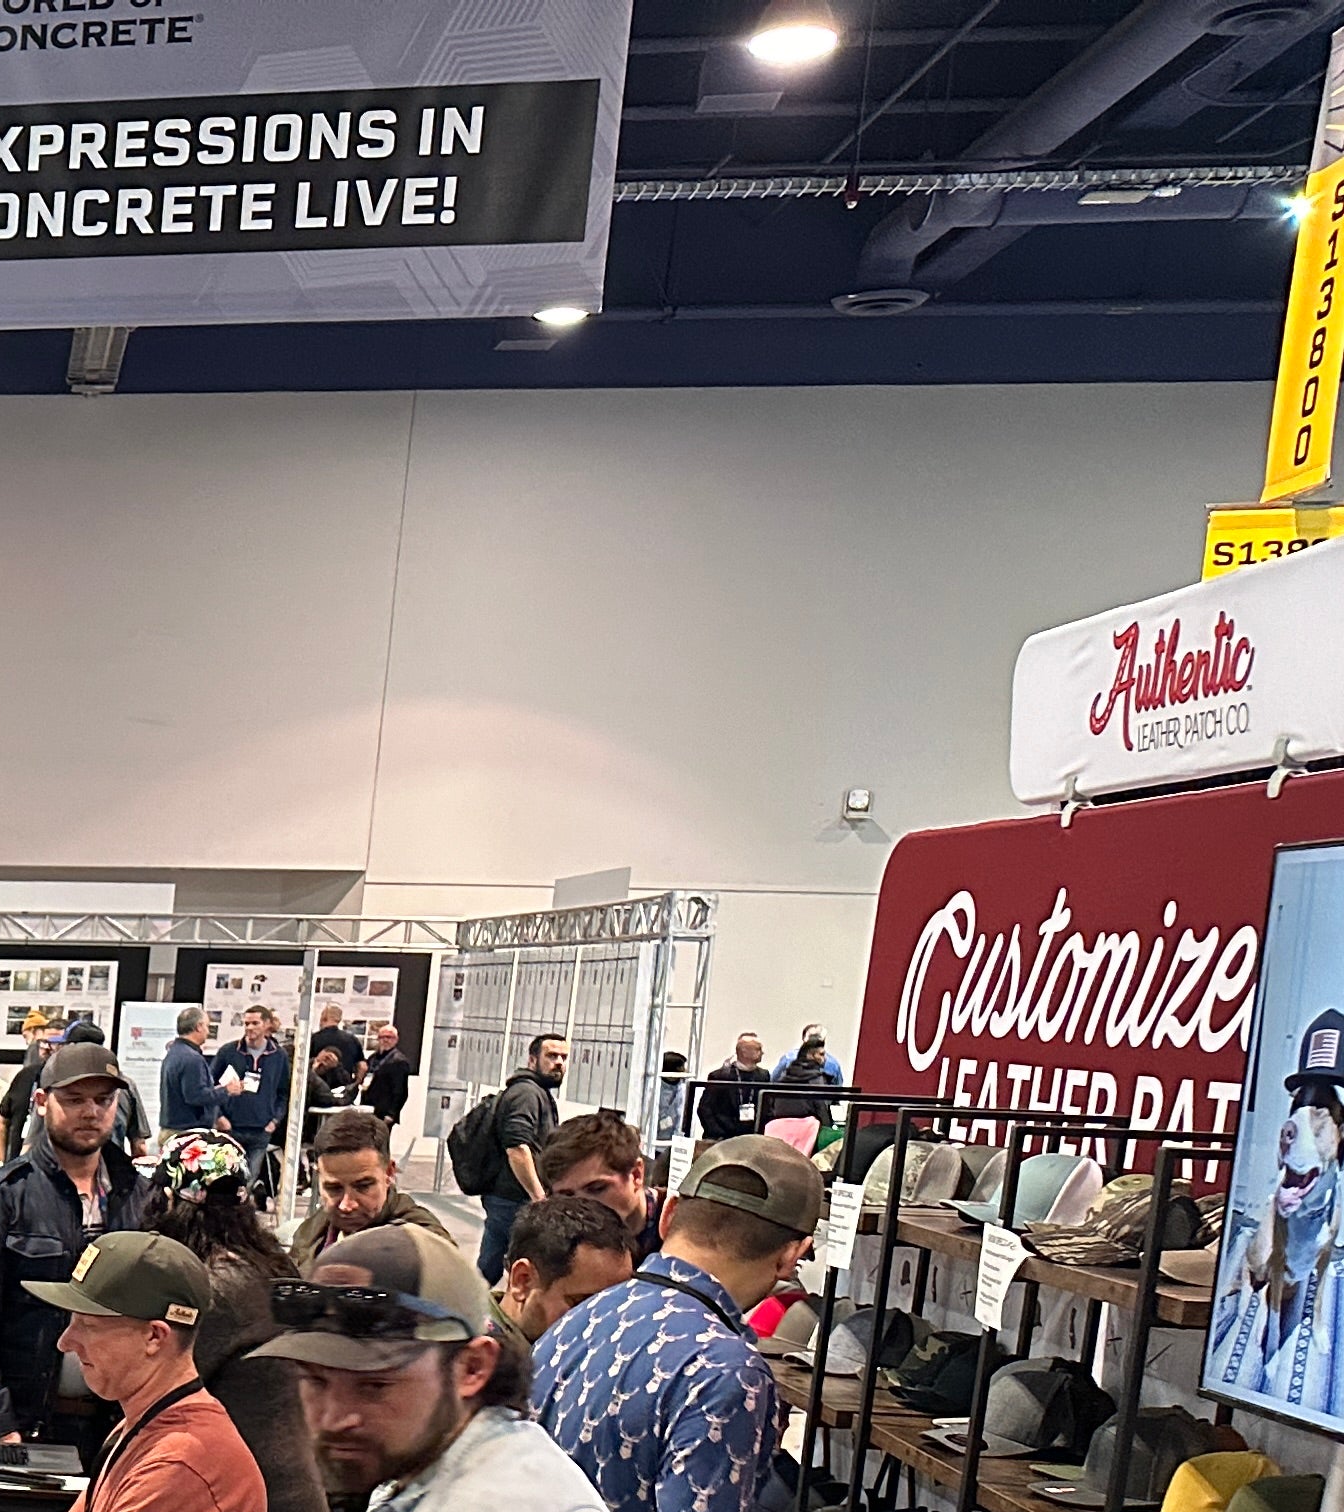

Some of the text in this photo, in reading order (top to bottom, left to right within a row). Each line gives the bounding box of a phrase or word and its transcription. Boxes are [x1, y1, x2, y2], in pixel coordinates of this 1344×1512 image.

[417, 105, 486, 156] IN
[294, 176, 459, 231] LIVE!
[1212, 537, 1330, 567] S138
[1089, 611, 1255, 751] Authentic
[1137, 716, 1183, 752] LEATHER
[1185, 708, 1222, 743] PATCH
[896, 887, 1258, 1073] Customize
[932, 1057, 1118, 1167] LEATHER
